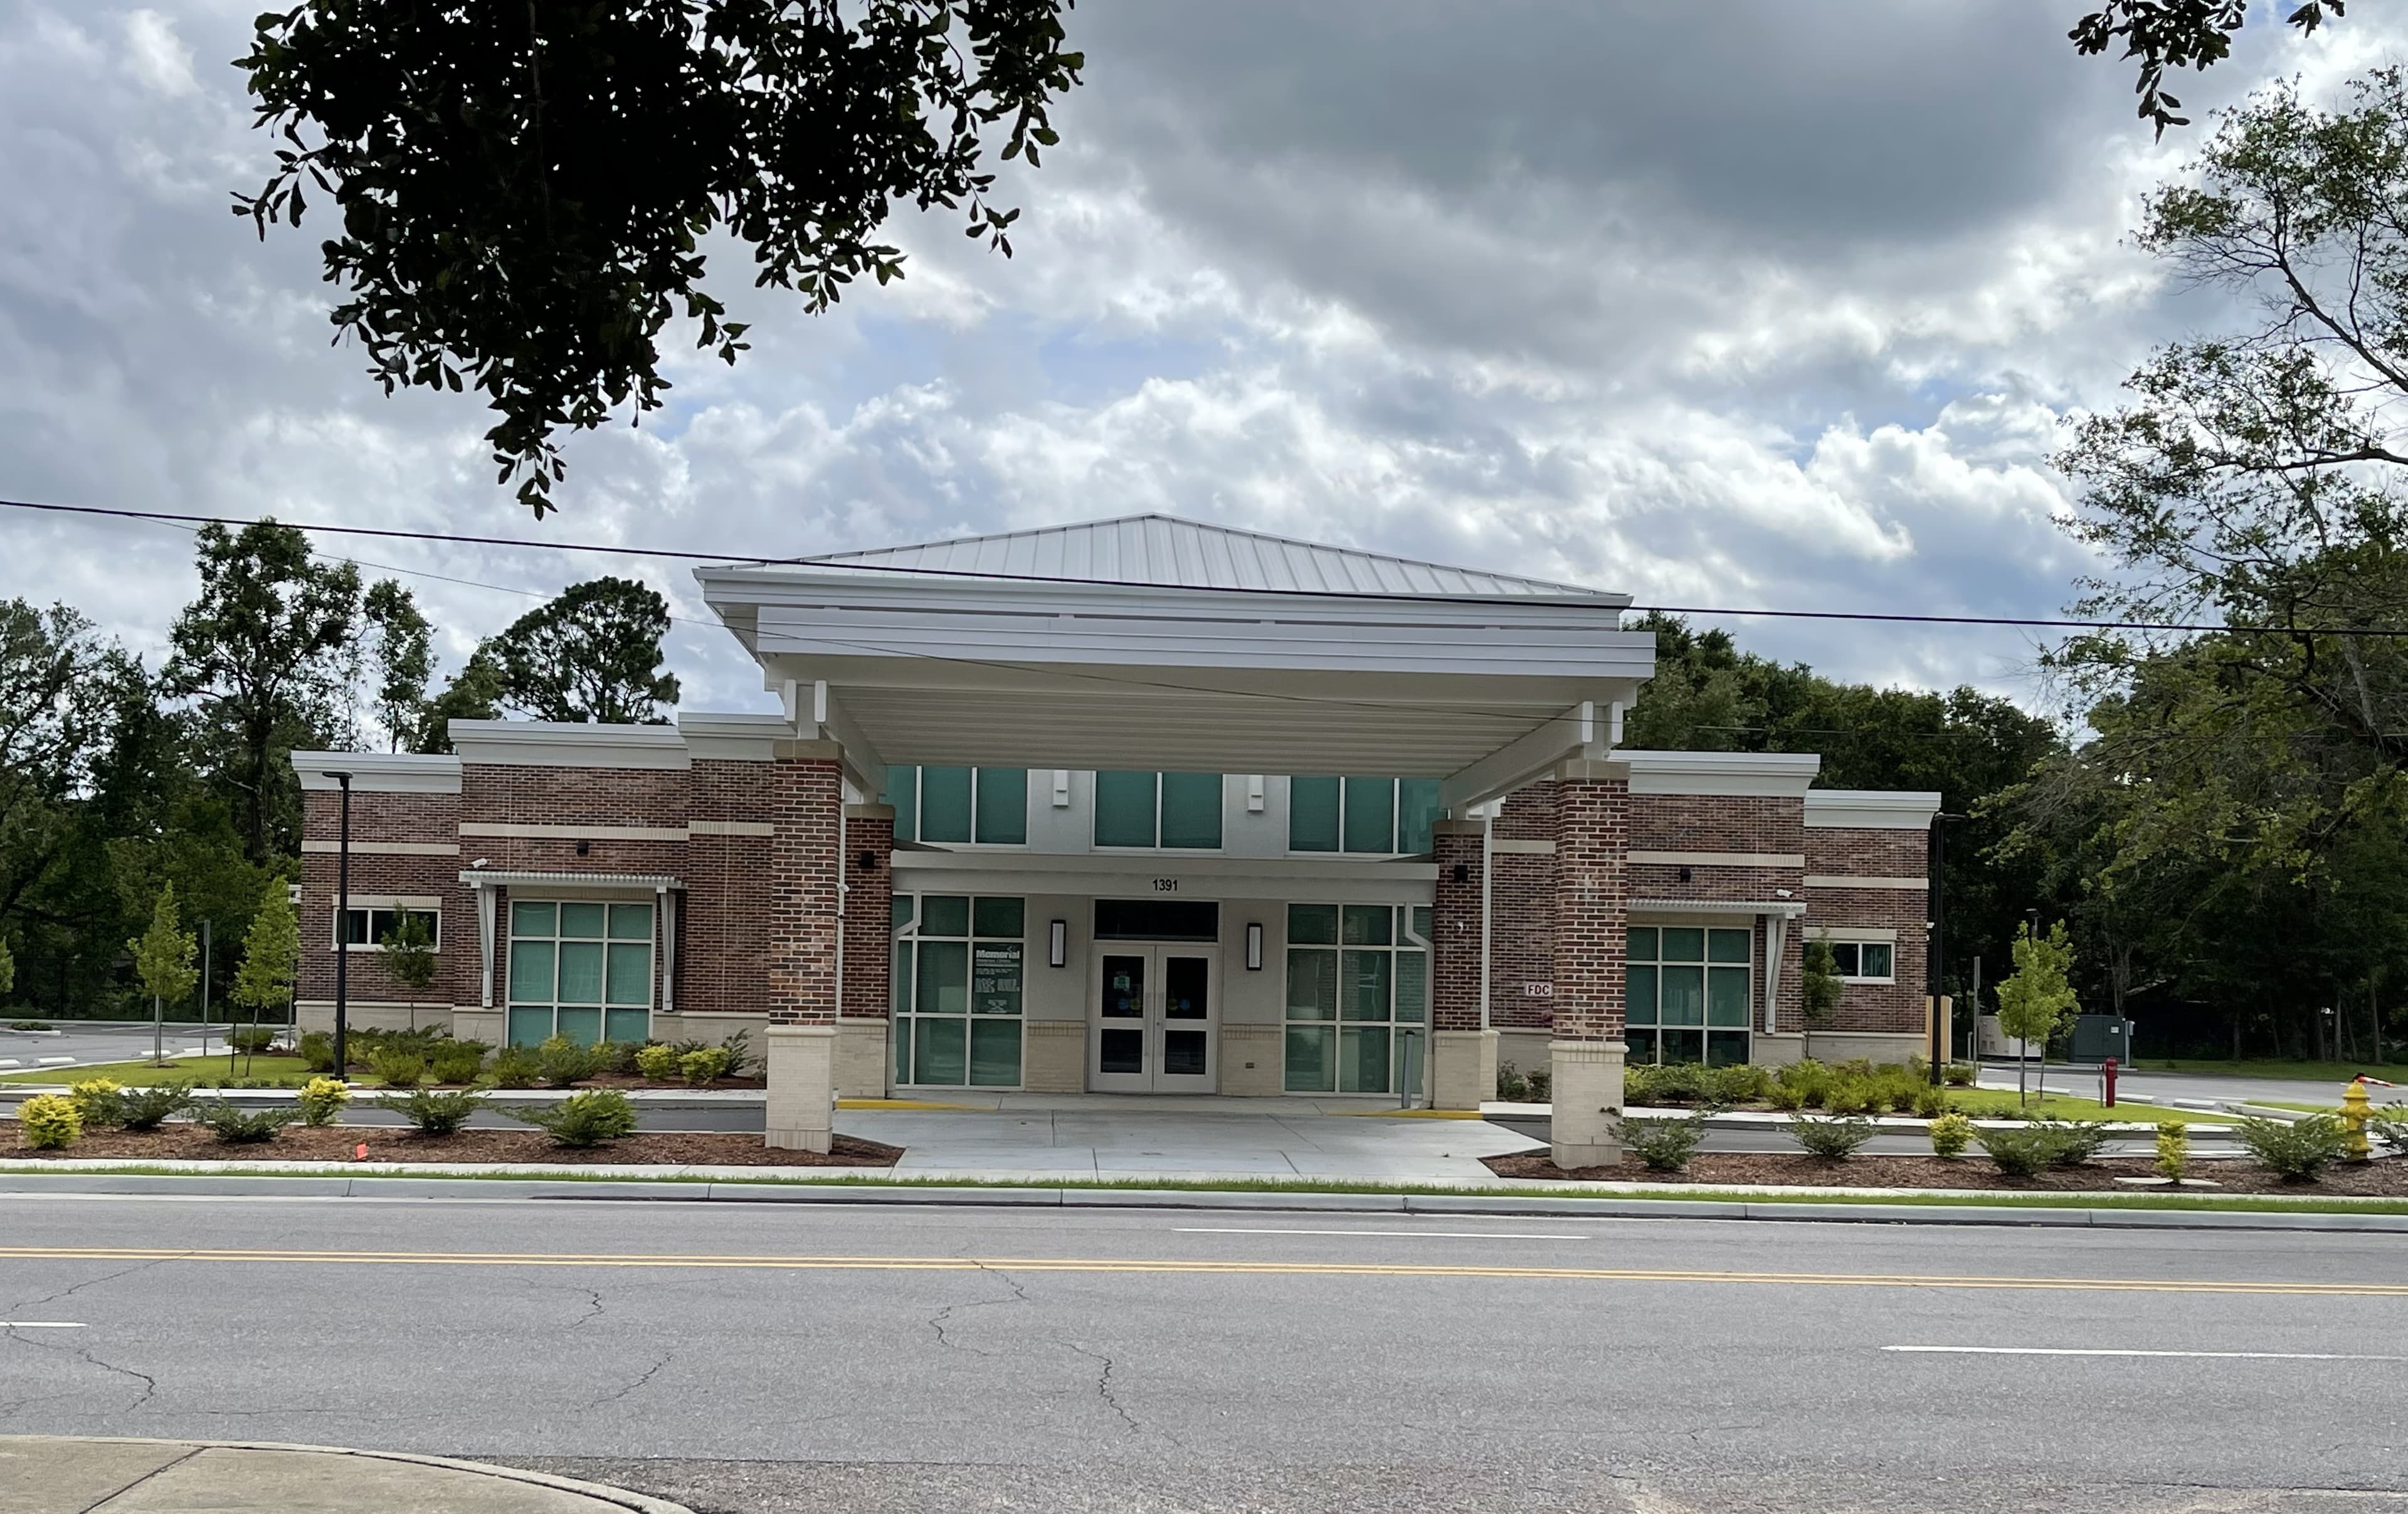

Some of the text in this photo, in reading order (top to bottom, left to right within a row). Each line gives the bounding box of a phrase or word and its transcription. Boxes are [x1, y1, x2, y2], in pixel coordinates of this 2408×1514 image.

[1153, 879, 1178, 891] 1391
[976, 950, 1020, 959] Memorial
[1528, 985, 1550, 995] FDC
